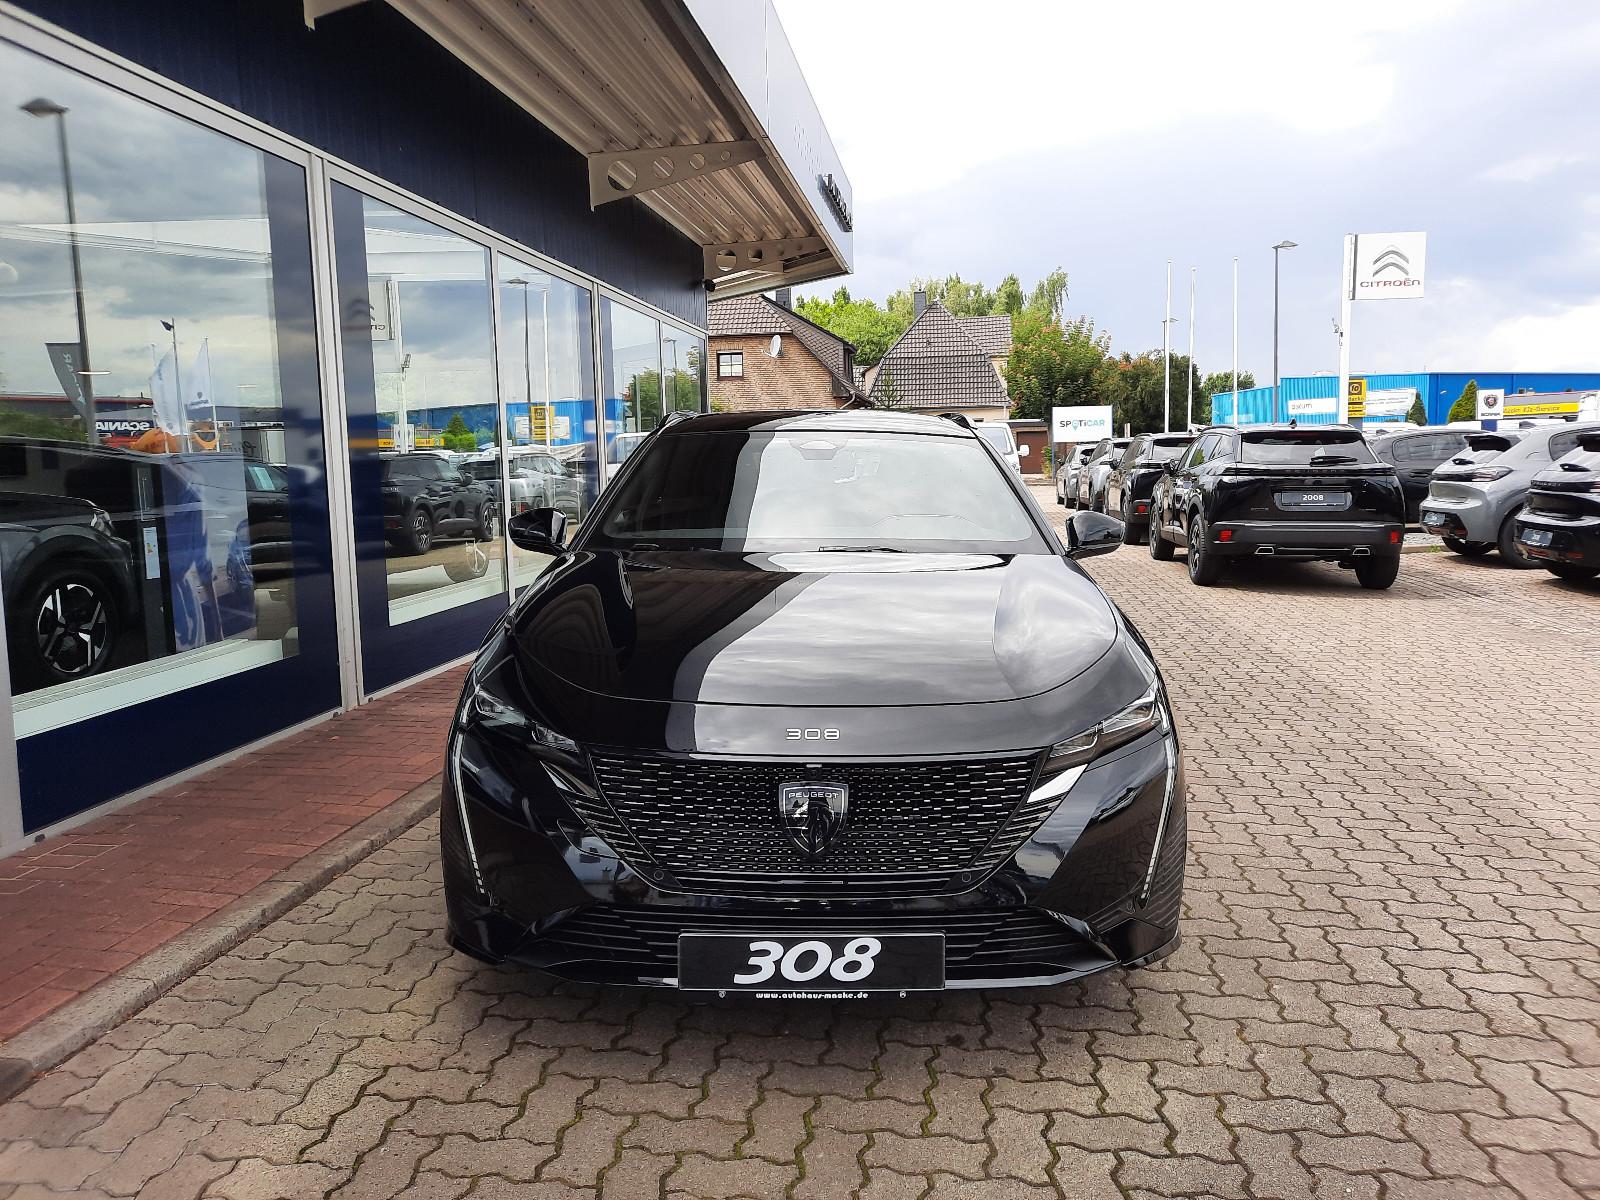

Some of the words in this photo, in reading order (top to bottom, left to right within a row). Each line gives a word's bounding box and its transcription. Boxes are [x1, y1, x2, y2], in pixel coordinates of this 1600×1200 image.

[1359, 278, 1421, 288] CITROËN
[1302, 493, 1324, 501] 2008
[785, 728, 841, 740] 308
[787, 791, 841, 799] PEUGEOT
[732, 936, 882, 985] 308
